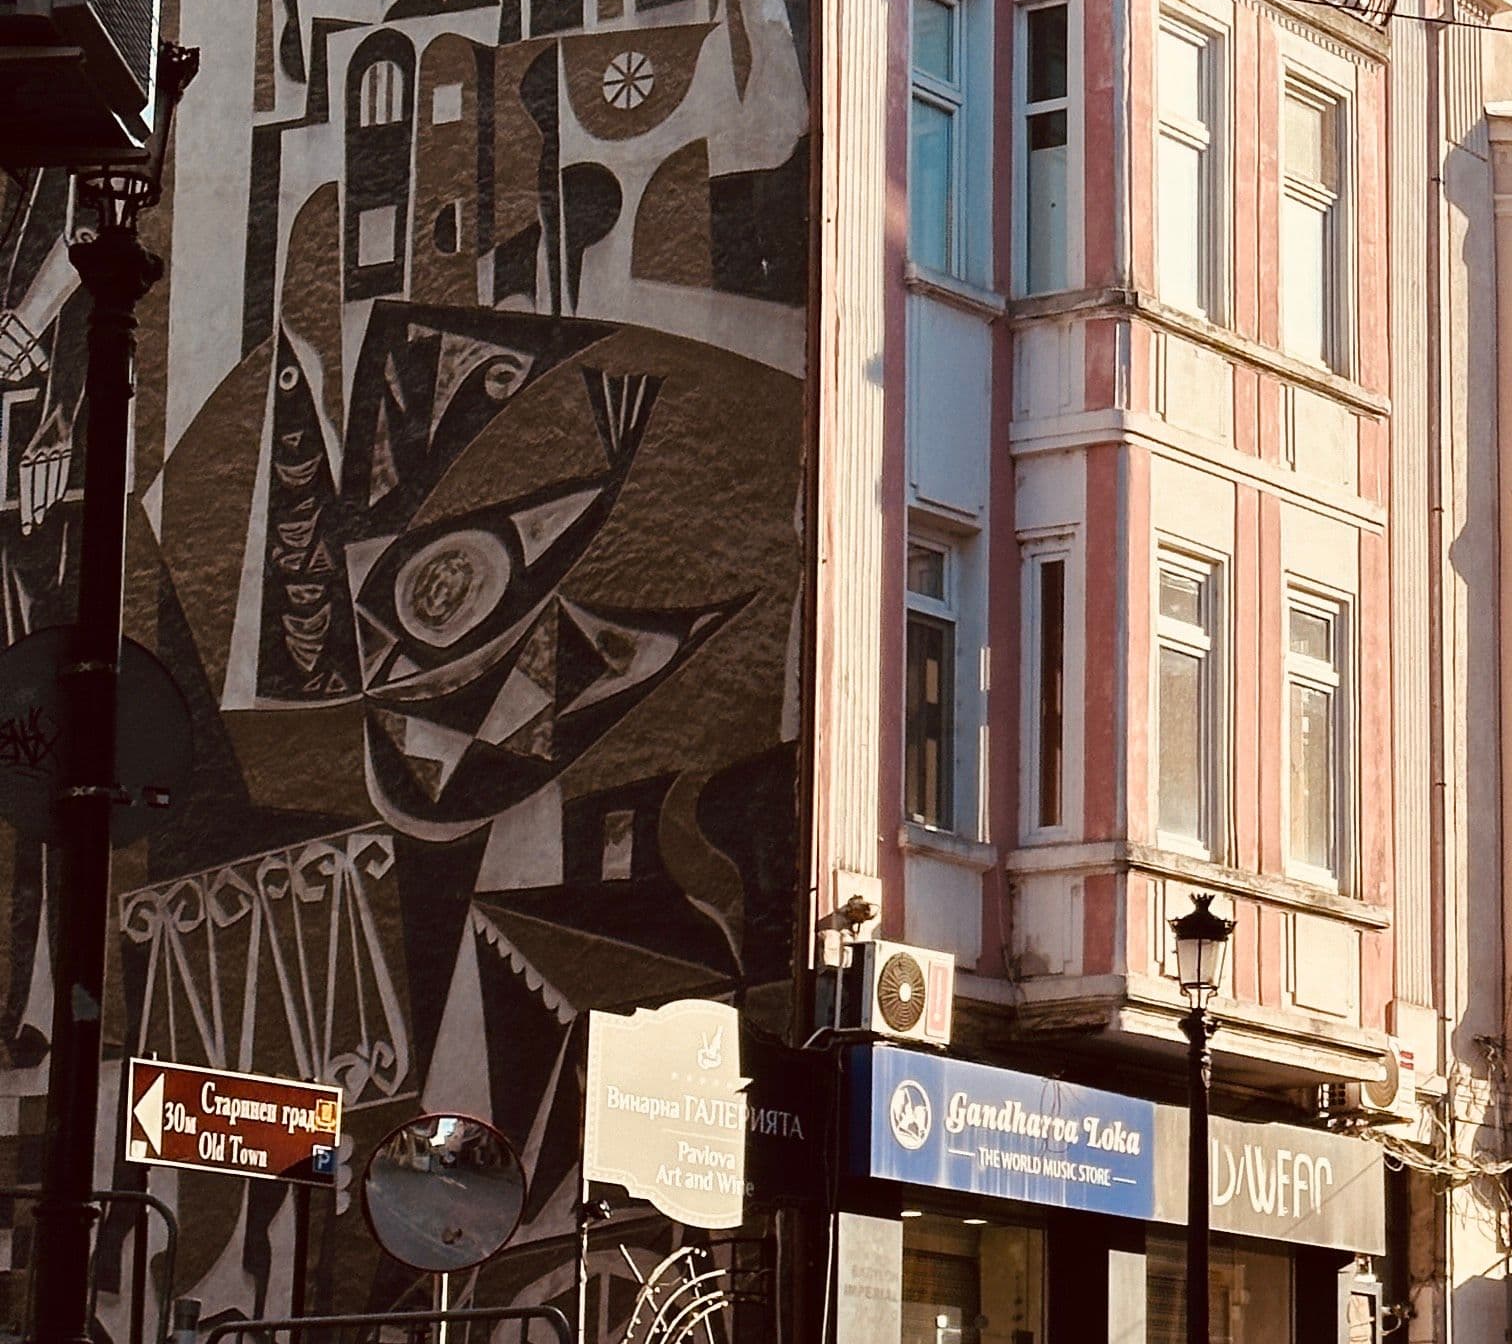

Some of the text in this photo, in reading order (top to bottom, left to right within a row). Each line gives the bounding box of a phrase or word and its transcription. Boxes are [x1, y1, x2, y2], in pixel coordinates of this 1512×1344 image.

[163, 1101, 197, 1135] 30м
[201, 1081, 278, 1125] Старинен
[607, 1085, 805, 1140] Винарна ГАЛЕРИЯТА
[945, 1090, 1142, 1156] Gandharva Loka
[198, 1131, 268, 1168] Old Town
[677, 1140, 736, 1169] Pavlova
[978, 1146, 1112, 1187] THE WORLD MUSIC STORE
[655, 1164, 755, 1197] Art and Wine
